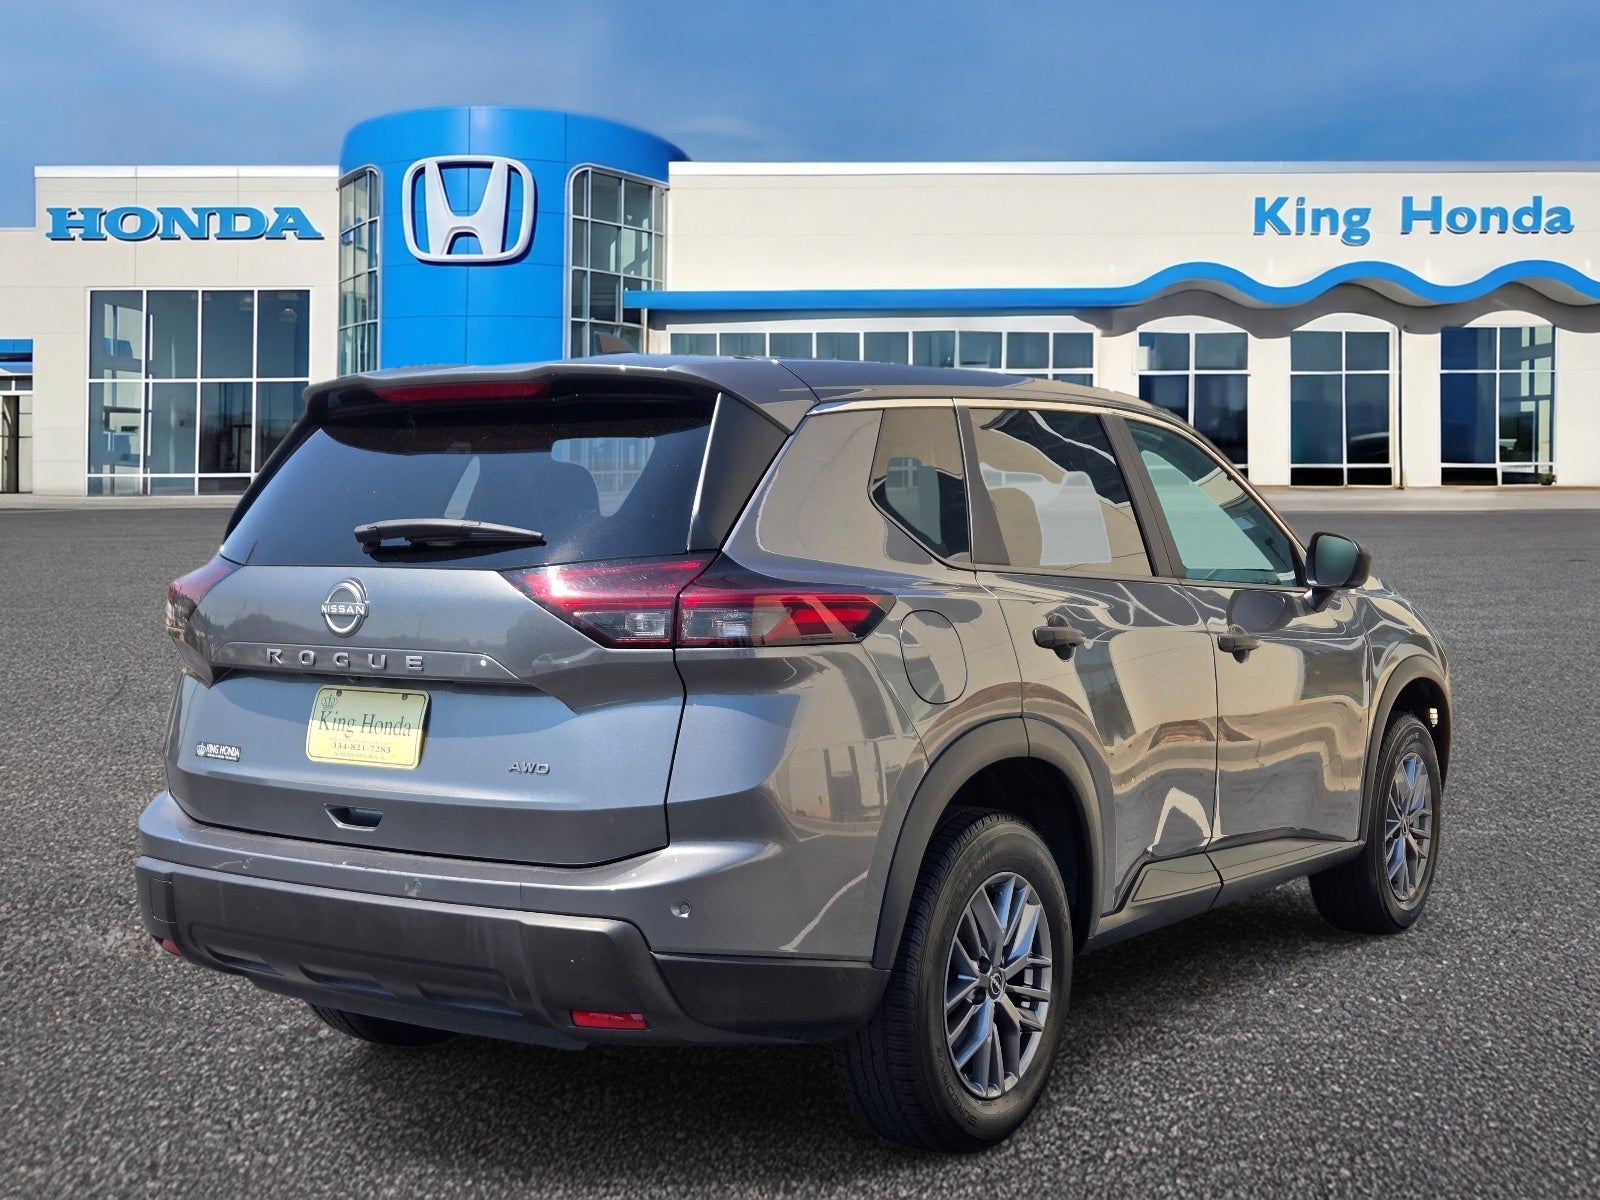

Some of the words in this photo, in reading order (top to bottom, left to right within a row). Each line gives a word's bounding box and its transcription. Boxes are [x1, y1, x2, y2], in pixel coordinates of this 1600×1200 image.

[45, 206, 324, 241] HONDA
[1253, 196, 1372, 246] King
[1401, 196, 1574, 234] Honda
[320, 604, 366, 616] NISSAN
[266, 648, 425, 672] ROGUE
[318, 710, 356, 738] King
[360, 713, 412, 737] Honda
[219, 745, 240, 758] HONDA
[331, 742, 391, 754] 334-821-7283
[508, 761, 551, 774] AWD
